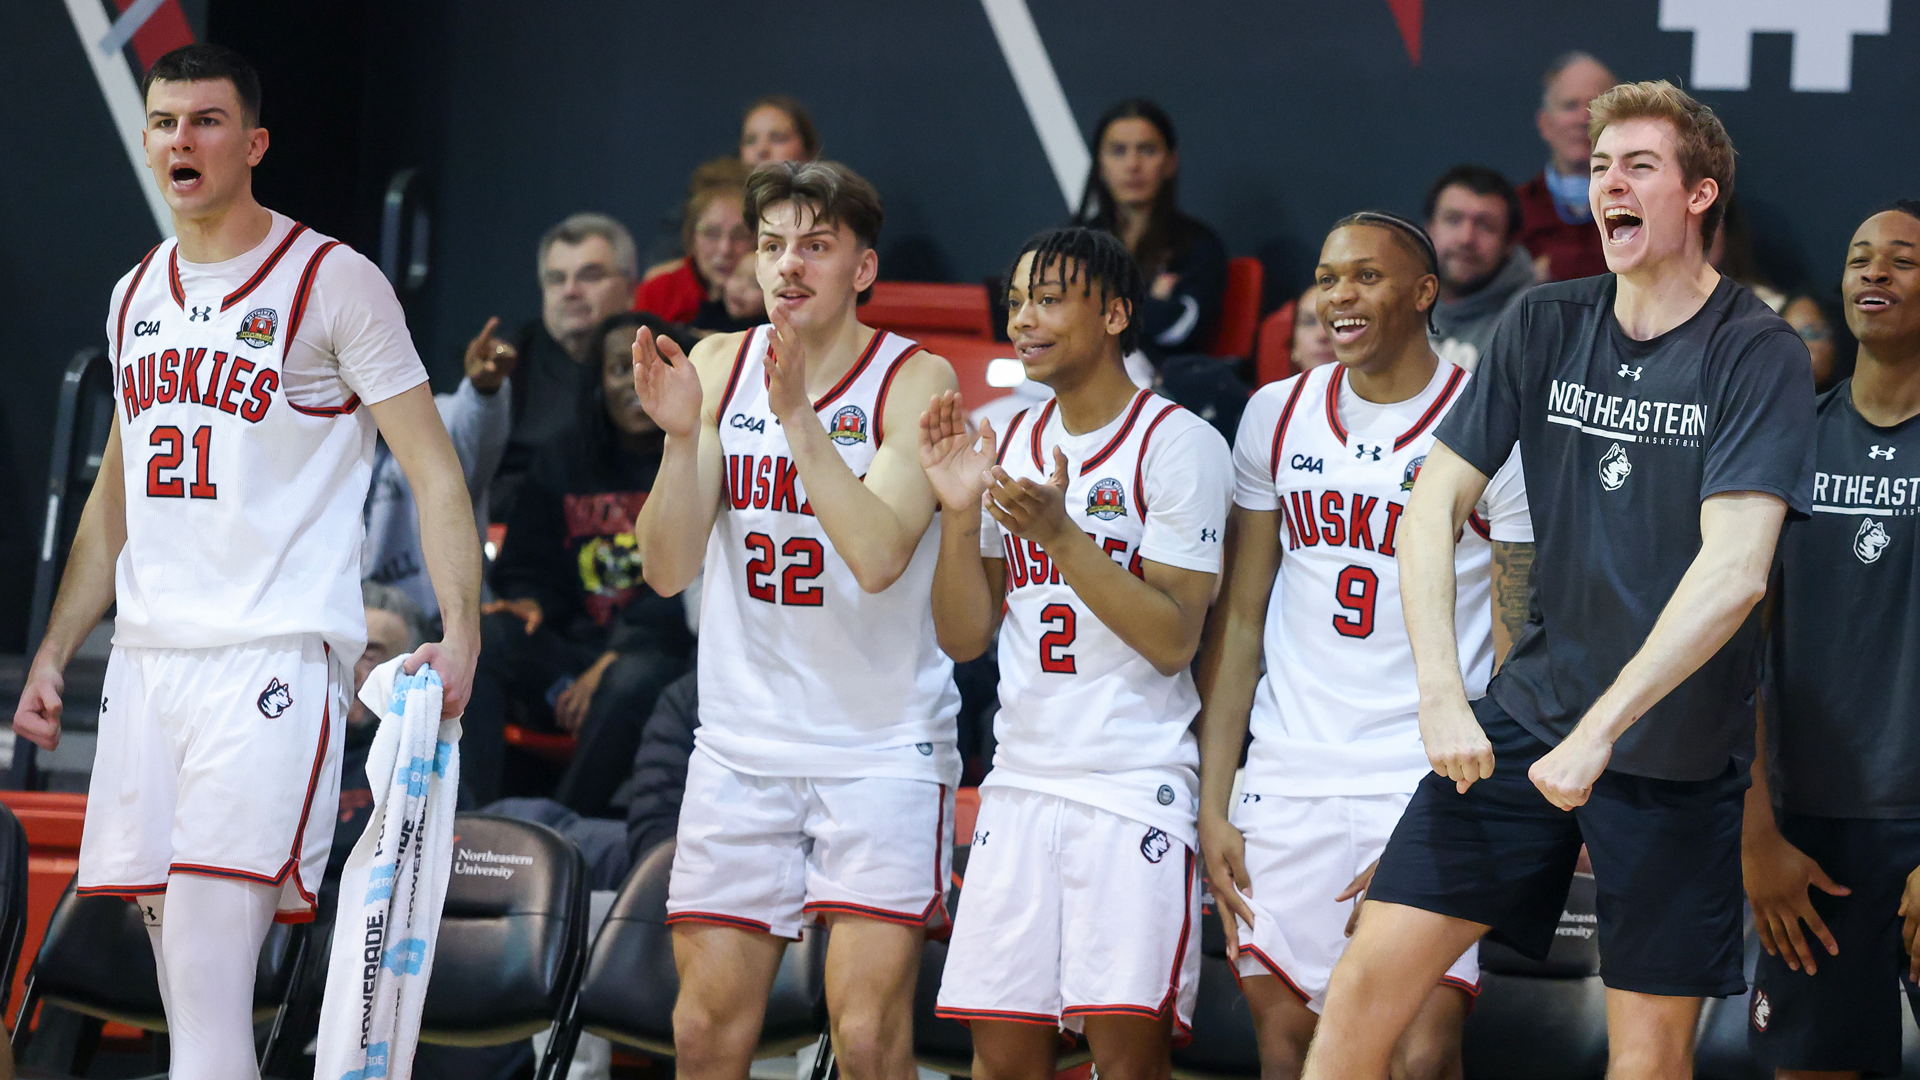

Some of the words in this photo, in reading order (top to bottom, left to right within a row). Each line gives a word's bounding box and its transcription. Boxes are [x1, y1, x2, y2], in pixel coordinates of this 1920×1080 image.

[134, 320, 161, 337] CAA
[122, 347, 279, 425] HUSKIES
[730, 413, 765, 434] CAA
[1548, 379, 1708, 436] NORTHEASTERN
[147, 425, 217, 500] 21
[1291, 454, 1324, 475] CAA
[1895, 506, 1920, 516] BAS
[744, 531, 824, 606] 22
[1332, 564, 1379, 639] 9
[1039, 603, 1077, 674] 2
[454, 861, 515, 880] University
[457, 848, 534, 866] Northeastern
